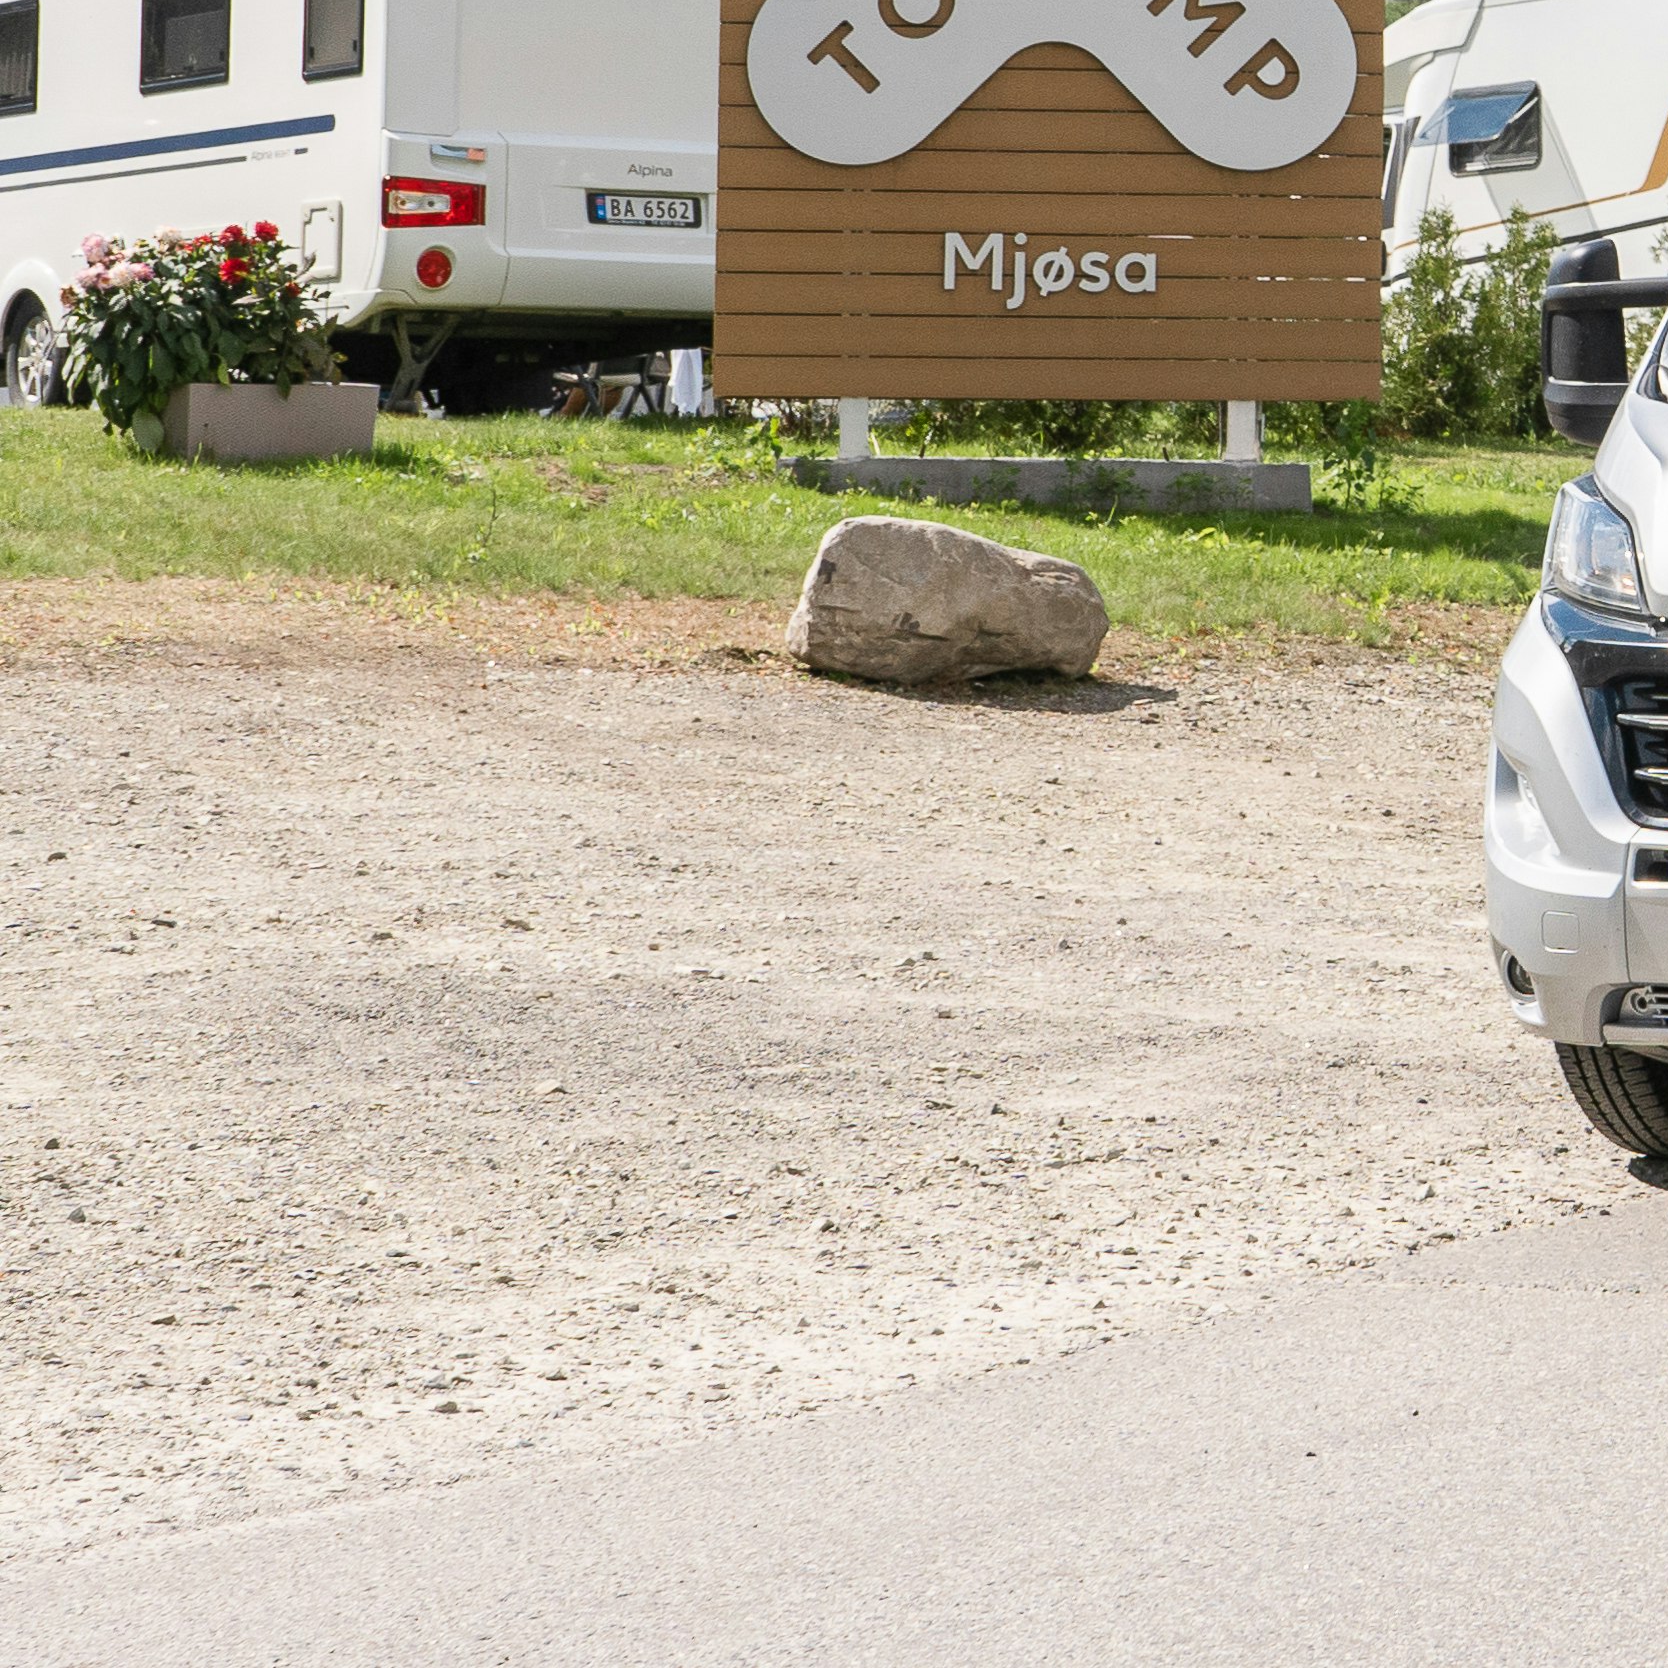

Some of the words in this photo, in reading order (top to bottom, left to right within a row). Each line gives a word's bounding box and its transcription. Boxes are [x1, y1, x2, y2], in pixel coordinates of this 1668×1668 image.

[627, 164, 673, 178] Alpina
[610, 198, 635, 217] BA
[643, 200, 690, 220] 6562
[943, 232, 1157, 309] Mjøsa
